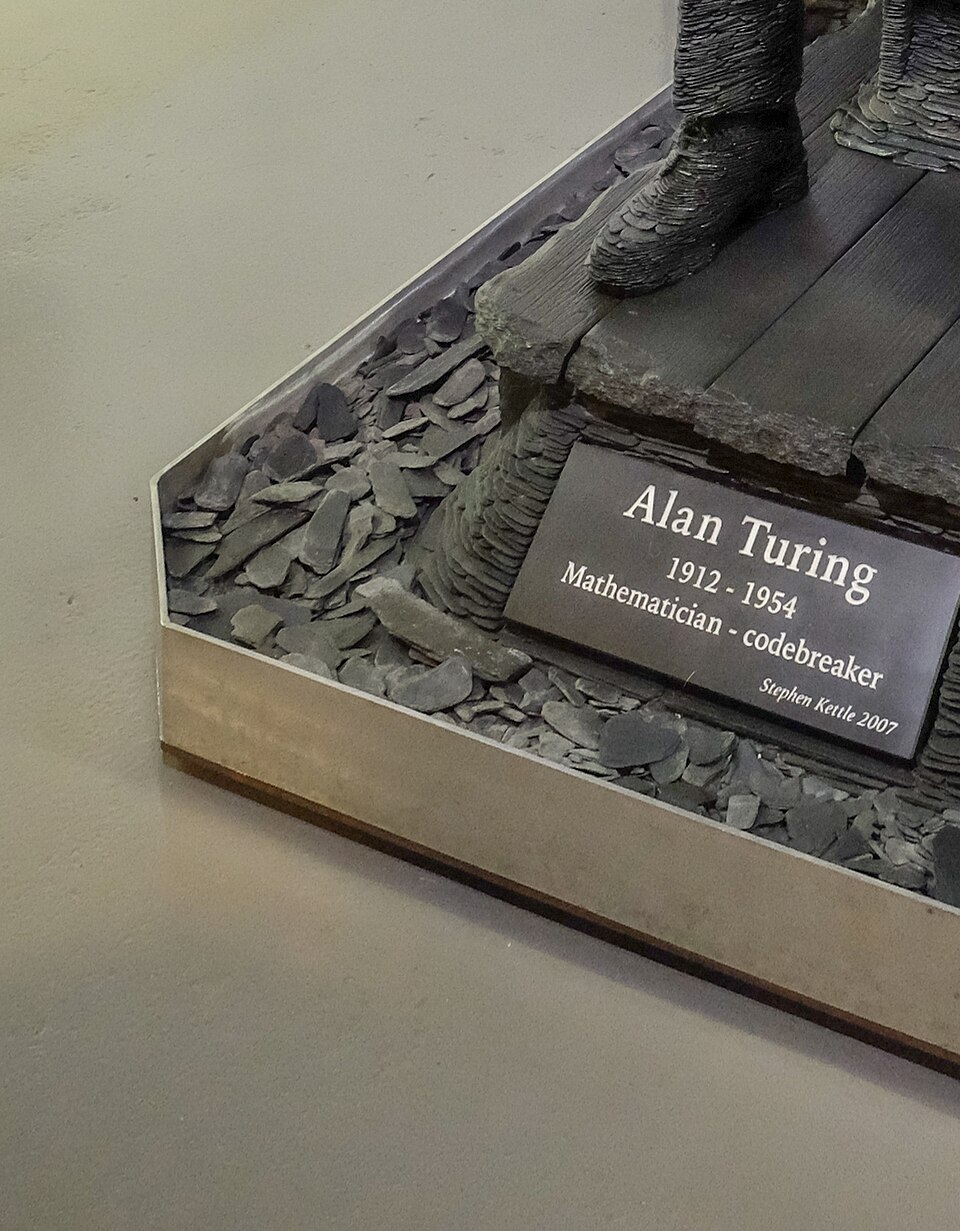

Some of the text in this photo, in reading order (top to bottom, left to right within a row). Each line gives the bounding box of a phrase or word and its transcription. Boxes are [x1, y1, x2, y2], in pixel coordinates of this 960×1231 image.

[622, 484, 879, 606] Alan Turing
[666, 557, 798, 620] 1912 - 1954
[560, 560, 884, 691] Mathematician - codebreaker
[759, 677, 899, 735] Stephen Kettle 2007
